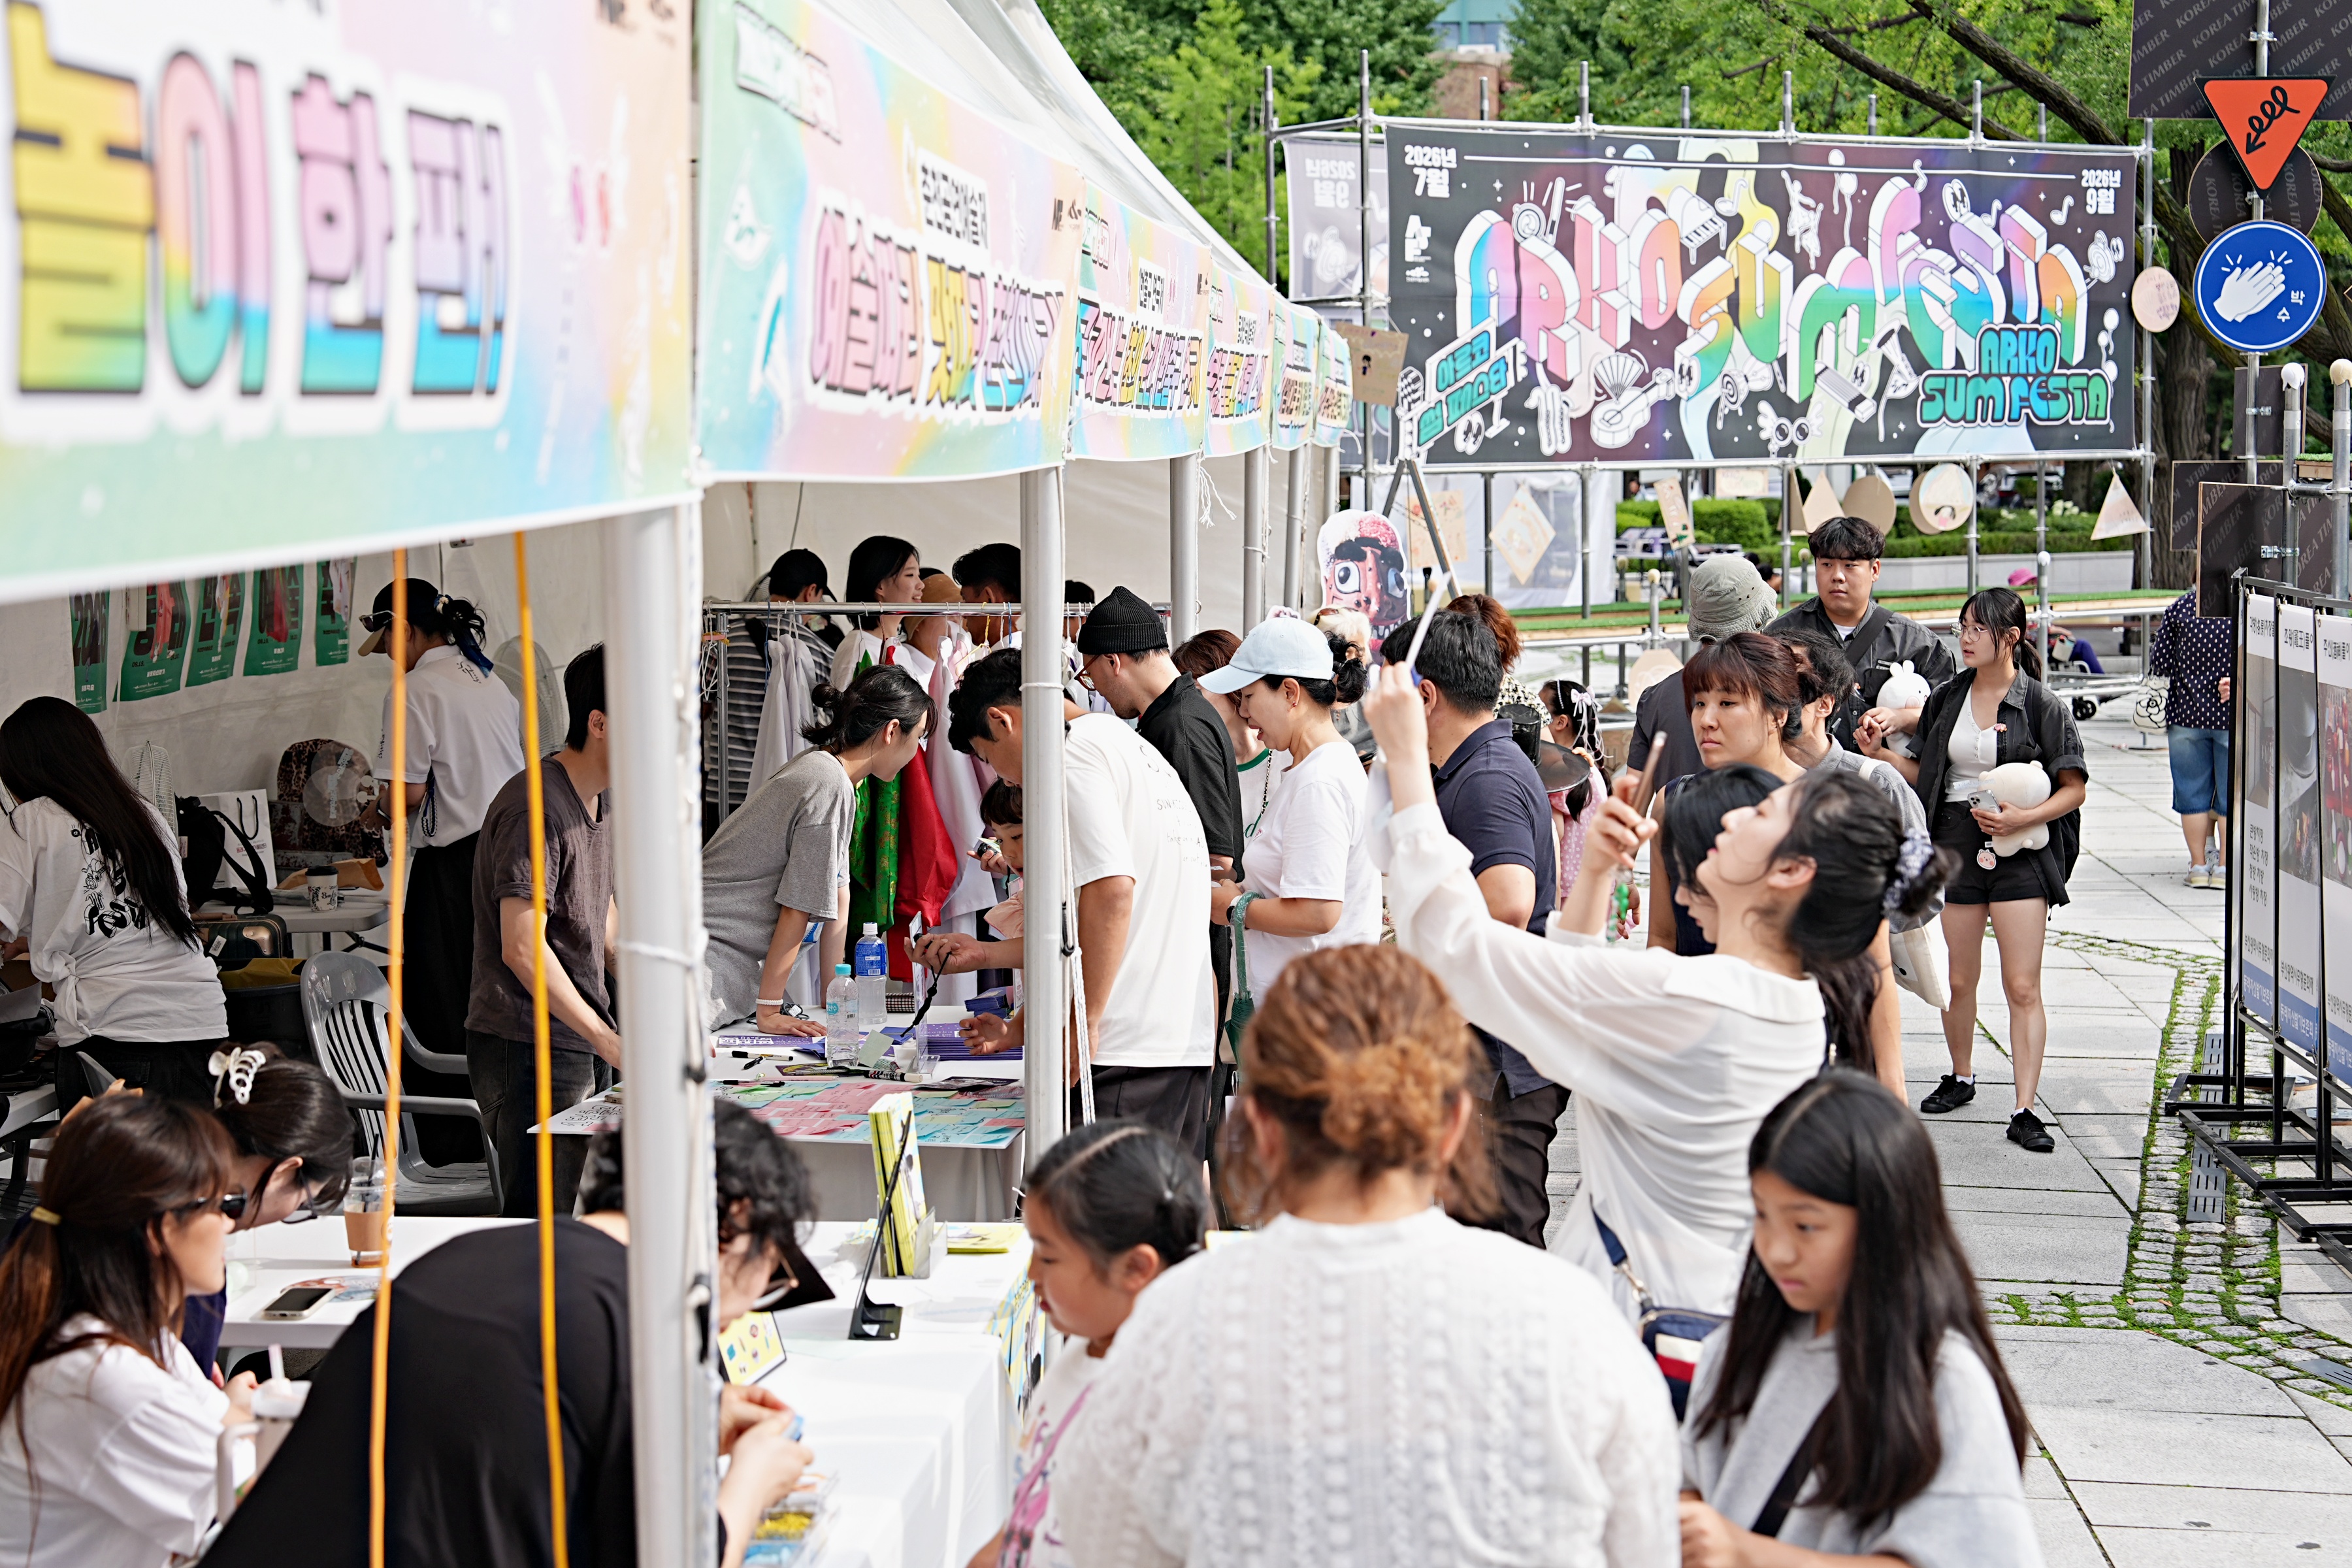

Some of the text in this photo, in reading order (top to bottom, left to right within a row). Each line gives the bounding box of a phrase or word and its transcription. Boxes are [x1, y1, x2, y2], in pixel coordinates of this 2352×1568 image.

[2142, 48, 2187, 88] TIMBER
[2192, 12, 2232, 49] KOREA
[2208, 33, 2248, 69] KOREA
[2269, 18, 2309, 52] IMBER
[1404, 144, 1457, 169] 2026년
[1413, 167, 1450, 198] 7월
[2082, 169, 2121, 189] 2026년
[2086, 188, 2115, 214] 9월
[1436, 331, 1490, 392] 아르코
[1979, 326, 2057, 374] ARKO
[1446, 356, 1508, 427] 페스타
[1921, 371, 2109, 423] SUM FESTA
[2327, 992, 2352, 1025] 부산광역시무형문
